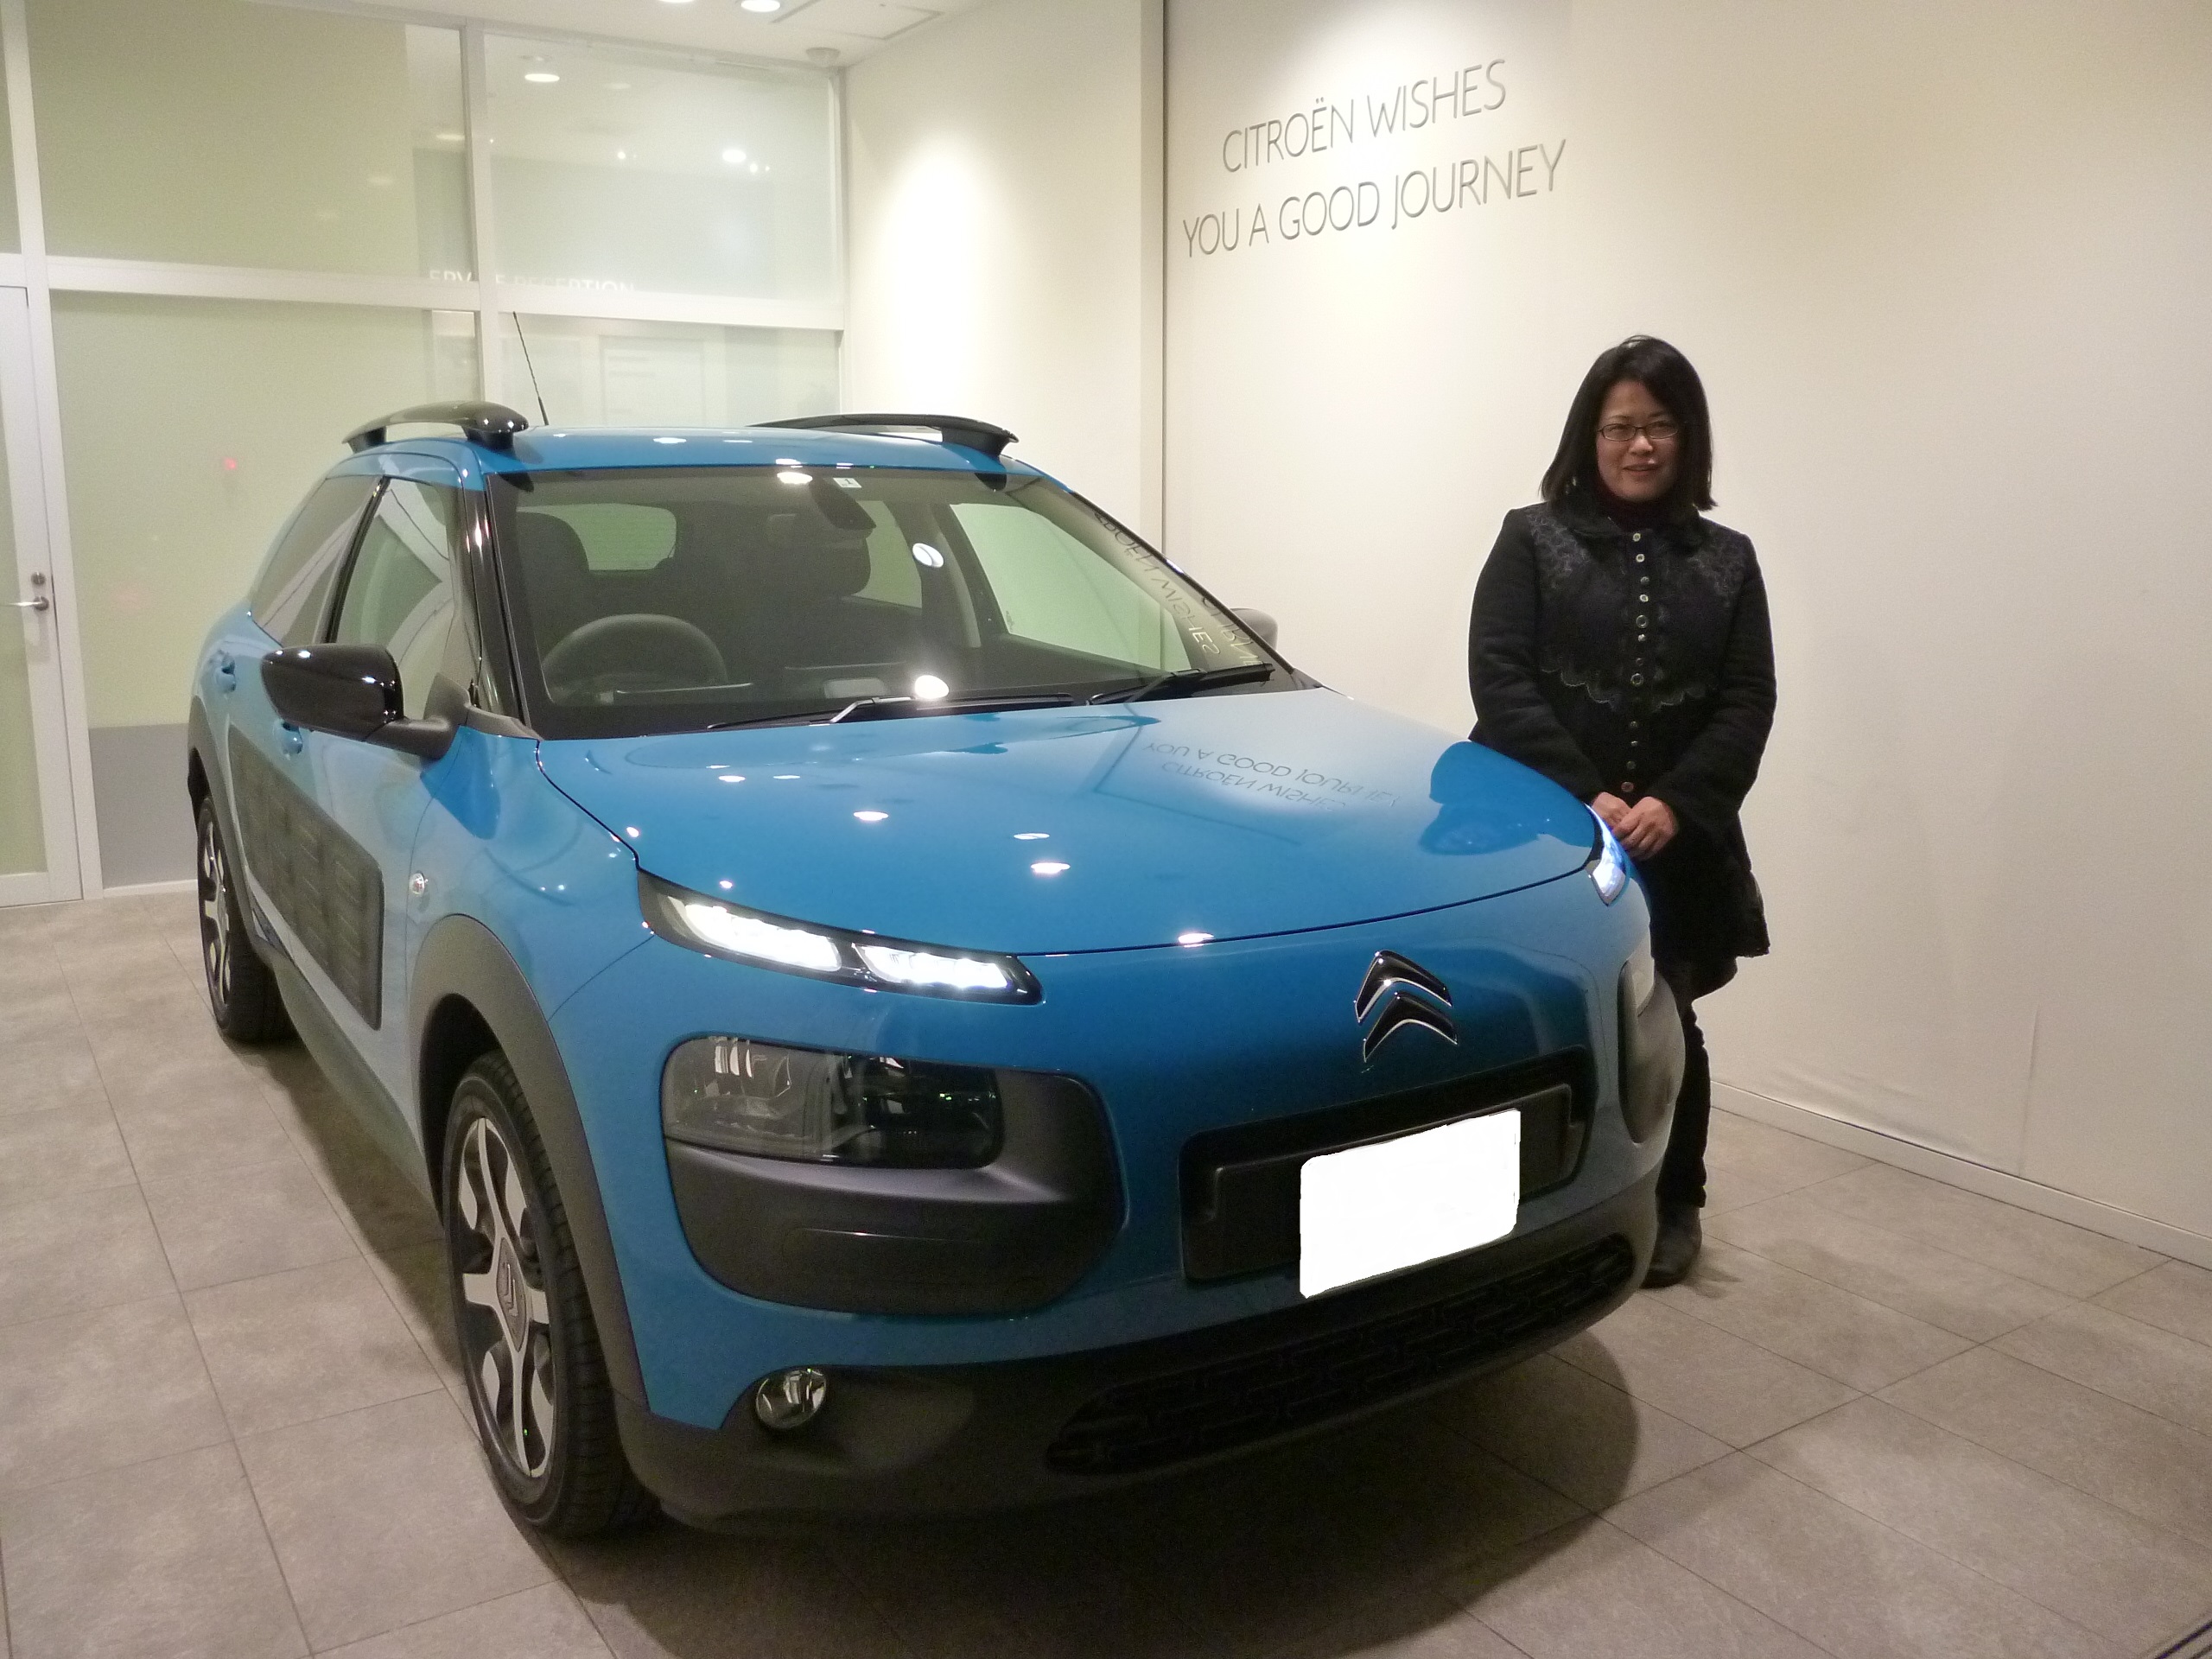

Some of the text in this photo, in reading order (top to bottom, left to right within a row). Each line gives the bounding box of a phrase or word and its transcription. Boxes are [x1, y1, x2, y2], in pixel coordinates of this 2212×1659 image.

[1223, 58, 1506, 173] CITROËN WISHES
[1183, 138, 1567, 257] YOU A GOOD JOURNEY
